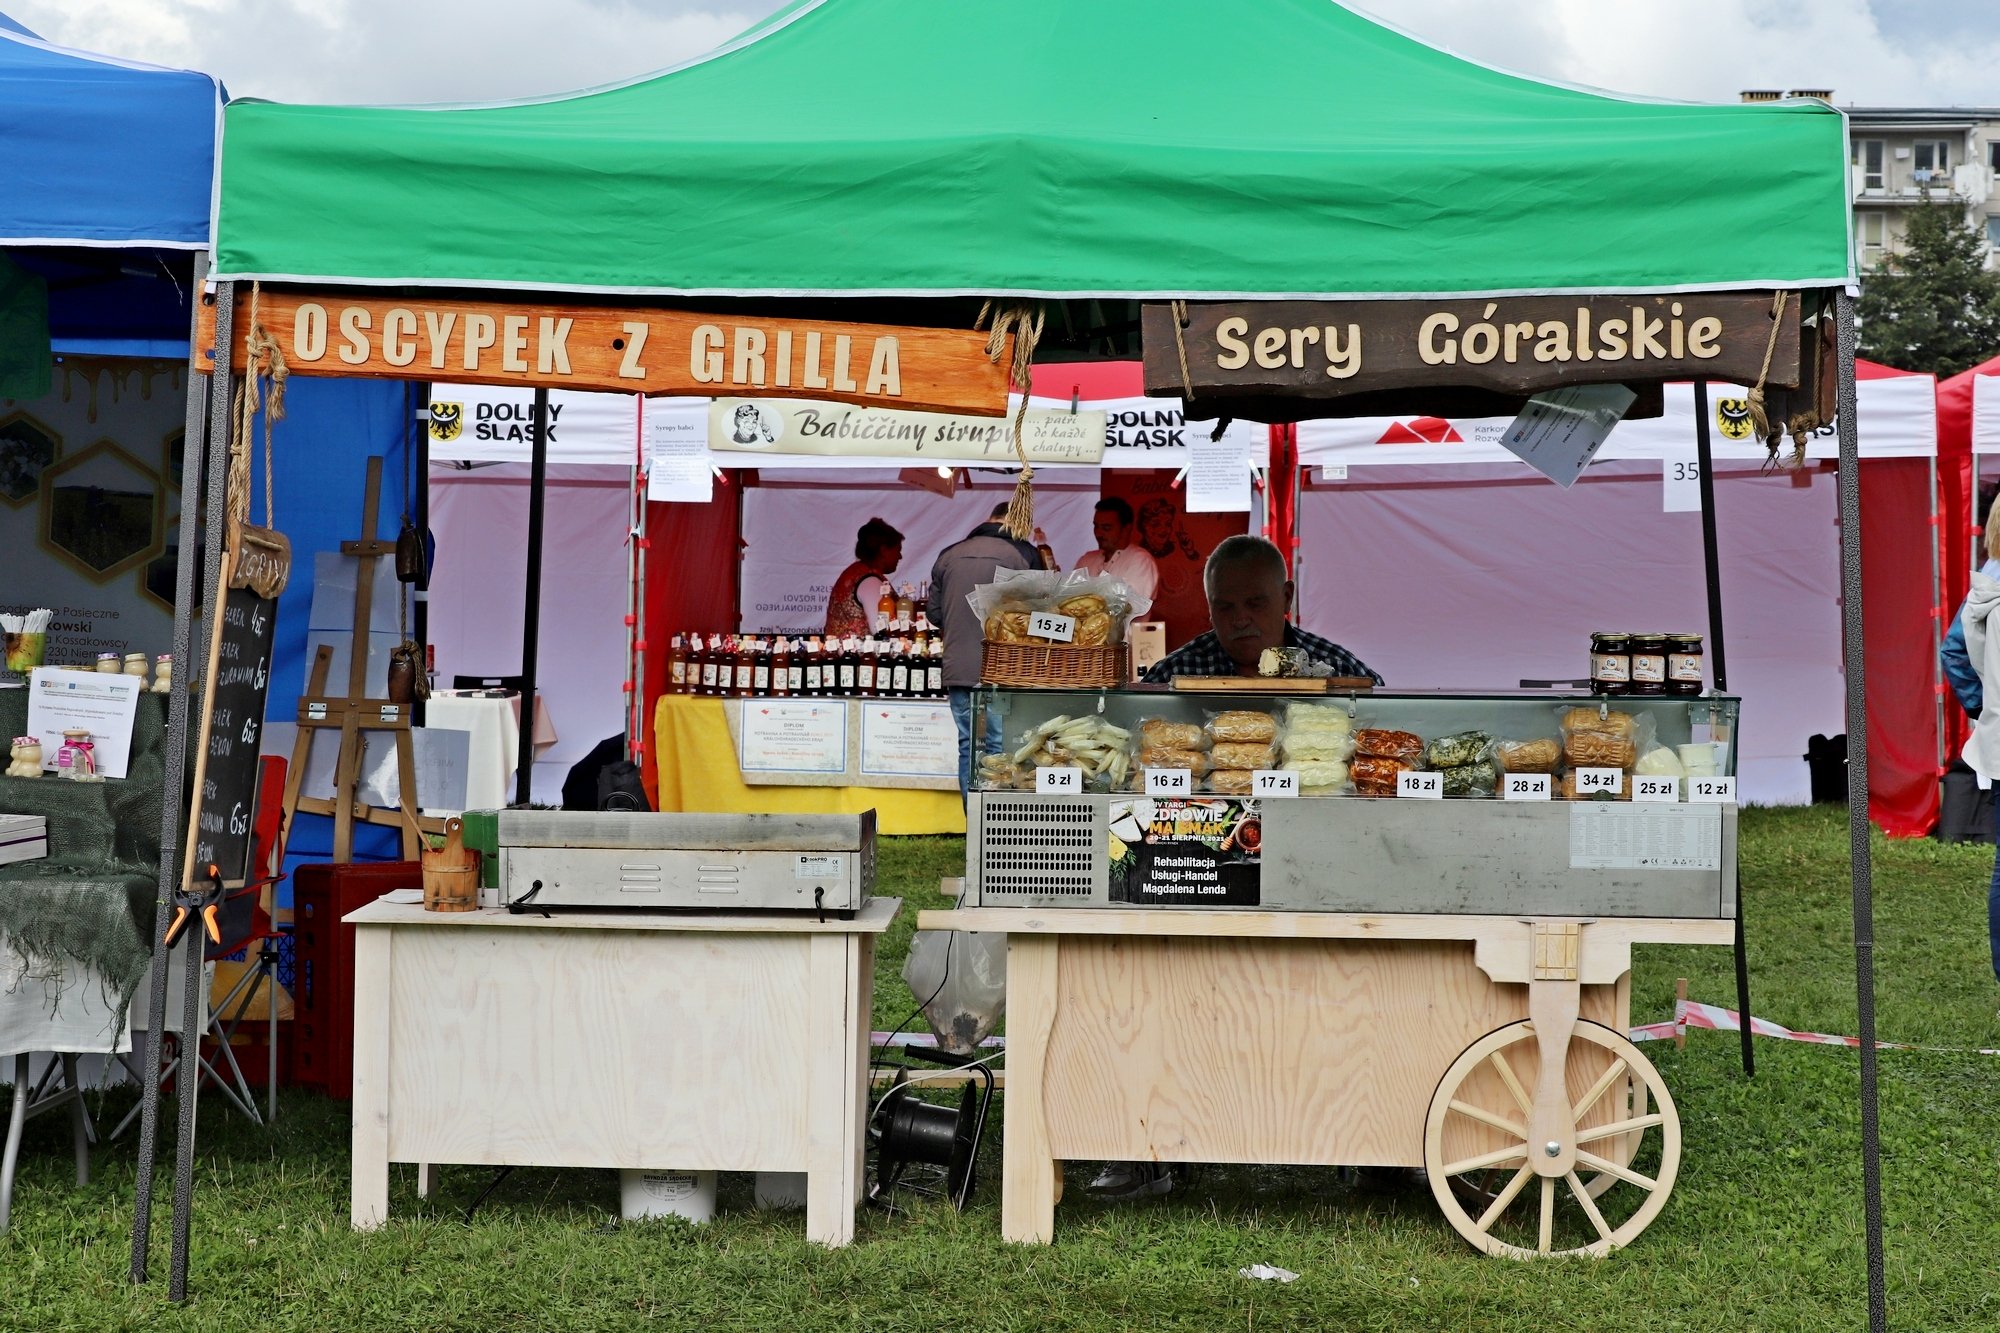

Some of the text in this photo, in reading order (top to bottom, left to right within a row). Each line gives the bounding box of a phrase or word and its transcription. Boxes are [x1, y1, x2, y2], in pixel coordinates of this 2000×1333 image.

[1215, 302, 1723, 379] Sery Góralskie
[293, 302, 902, 397] OSCYPEK Z GRILLA
[1044, 413, 1079, 428] patří
[793, 408, 1016, 455] Babiččiny sirupy
[1034, 426, 1087, 439] do každé
[1105, 425, 1186, 450] ŚLĄSK
[1474, 434, 1504, 443] Rozw
[1032, 440, 1081, 457] chalupy
[1673, 462, 1699, 481] 35
[63, 607, 120, 620] Pasieczne
[1037, 618, 1067, 633] 15 zł
[56, 635, 128, 650] Kossakowscy
[1048, 774, 1071, 785] 8 zł
[1152, 775, 1184, 787] 16 zł
[1260, 776, 1292, 788] 17 zł
[1404, 777, 1436, 790] 18 zł
[1512, 780, 1545, 792] 28 zł
[1583, 774, 1615, 786] 34 zł
[1640, 782, 1672, 794] 25 zł
[1696, 782, 1728, 795] 12 zł
[1163, 801, 1187, 809] TARGI
[1151, 808, 1223, 822] ZDROWIE
[1149, 821, 1225, 835] MA SMAK
[1153, 856, 1216, 869] Rehabilitacja
[1151, 870, 1218, 882] Usługi-Handel
[1142, 883, 1227, 895] Magdalena Lenda
